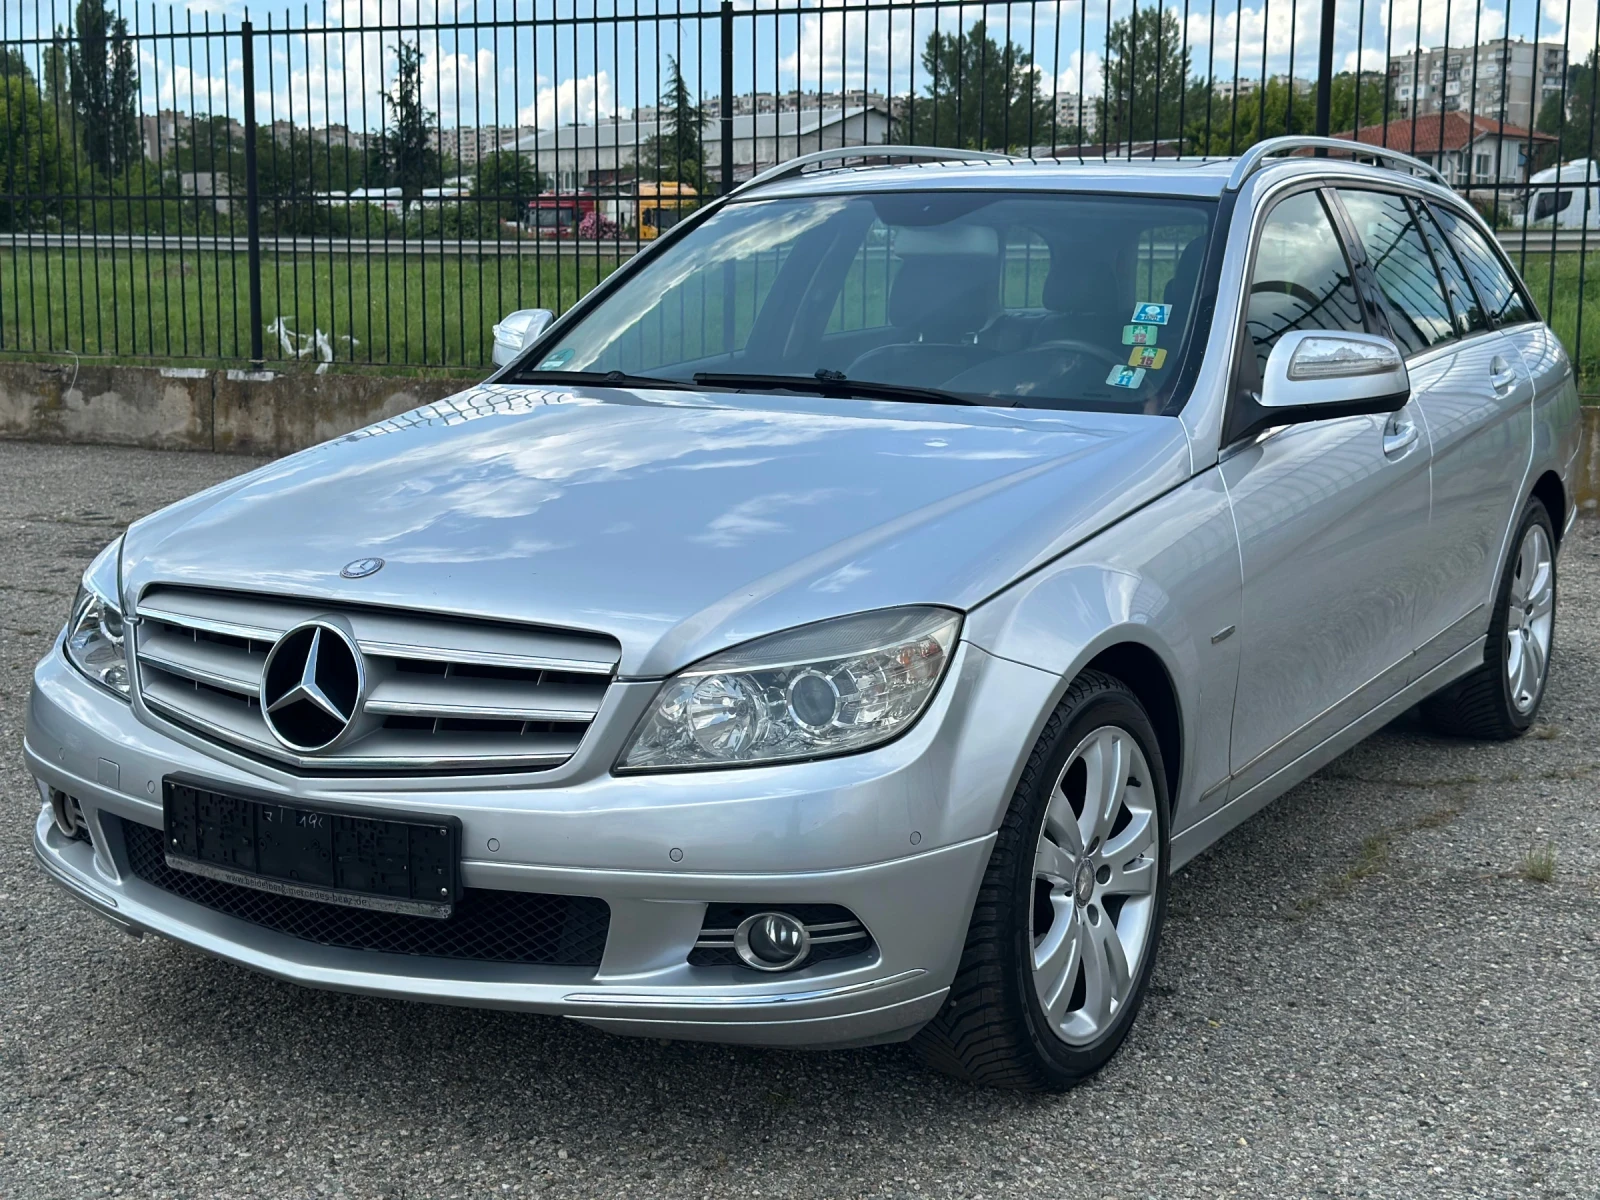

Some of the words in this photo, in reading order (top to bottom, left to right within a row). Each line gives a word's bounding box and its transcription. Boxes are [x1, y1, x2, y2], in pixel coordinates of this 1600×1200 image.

[1133, 334, 1146, 343] 12
[1140, 357, 1153, 365] 15
[1118, 376, 1133, 386] 11
